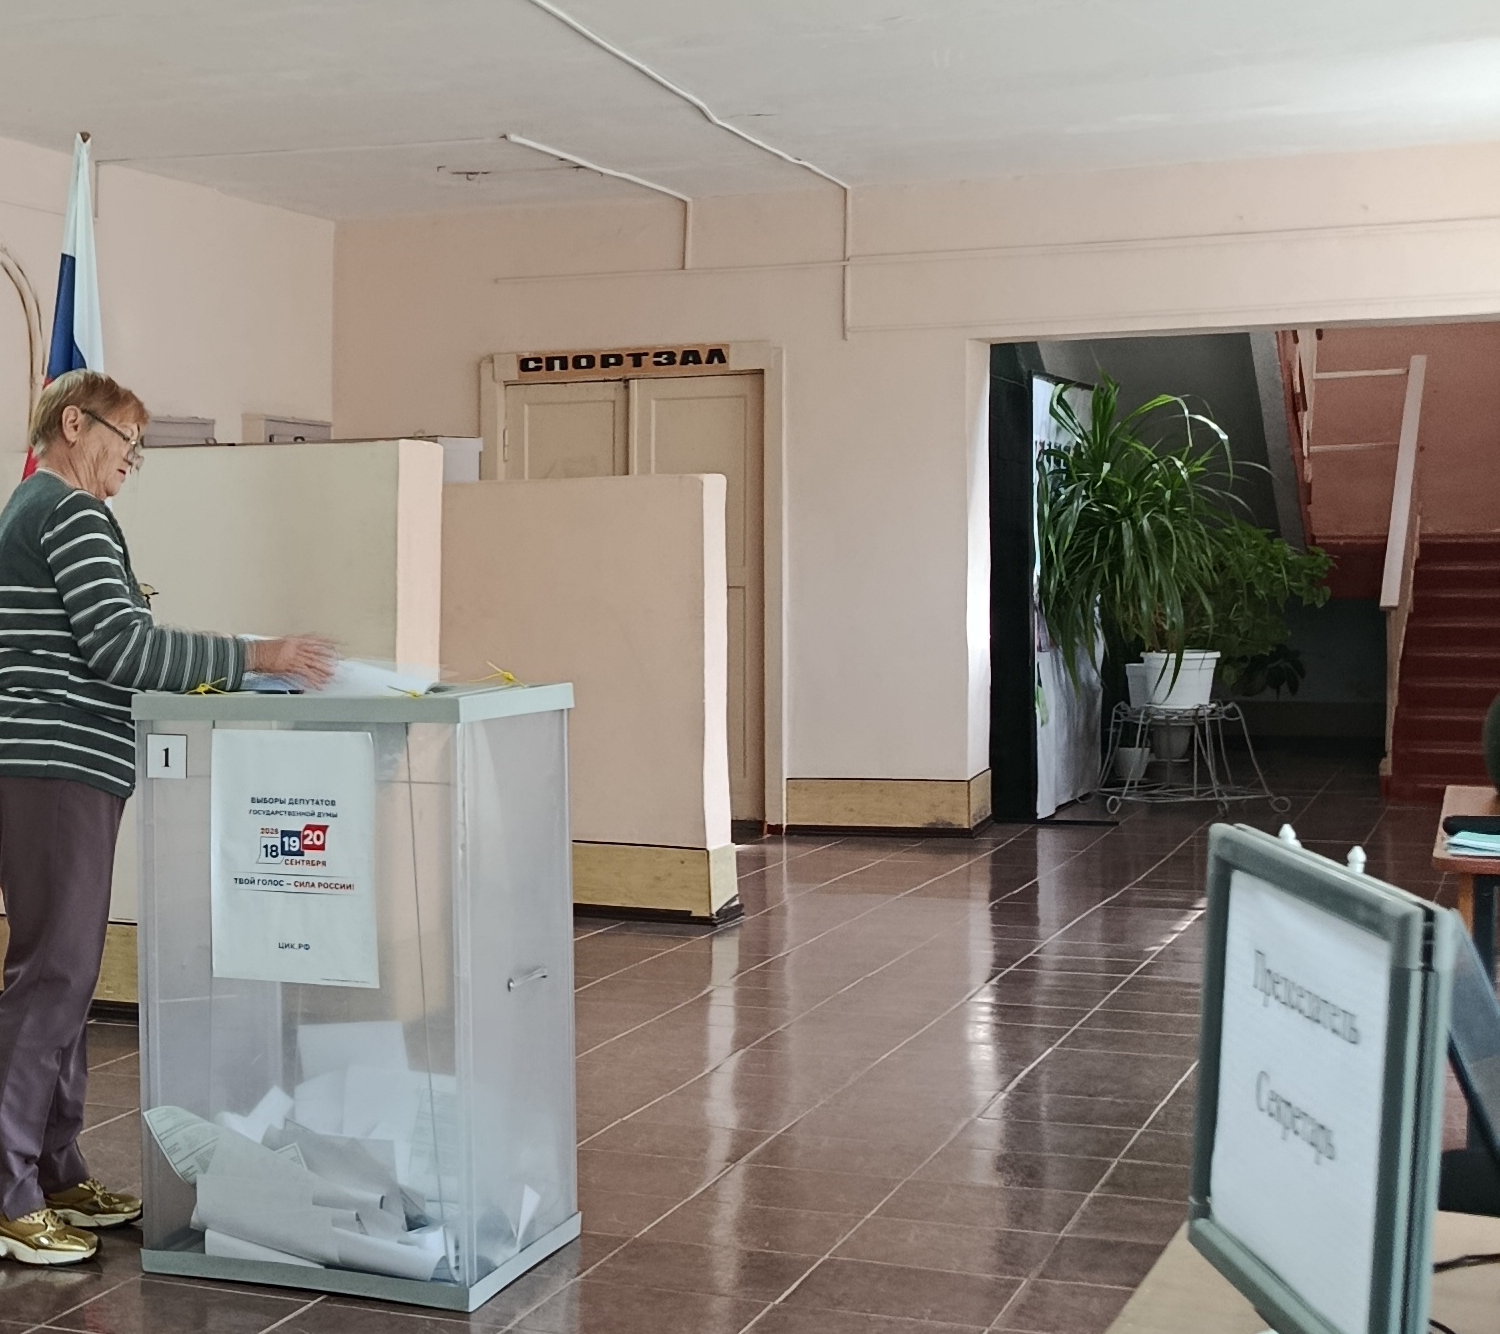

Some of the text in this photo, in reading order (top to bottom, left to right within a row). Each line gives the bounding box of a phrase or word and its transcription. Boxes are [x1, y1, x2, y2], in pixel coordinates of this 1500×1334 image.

[519, 348, 727, 372] СПОРТЗАЛ
[162, 747, 171, 768] 1
[250, 796, 337, 807] ВЫБОРЫ ДЕПУТАТОВ
[282, 836, 301, 852] 19
[303, 829, 325, 846] 20
[262, 844, 280, 859] 18
[284, 858, 327, 867] СЕНТЯБРЯ
[233, 877, 256, 885] ТВОЙ
[257, 878, 285, 887] ГОЛОС
[293, 880, 316, 889] СИЛА
